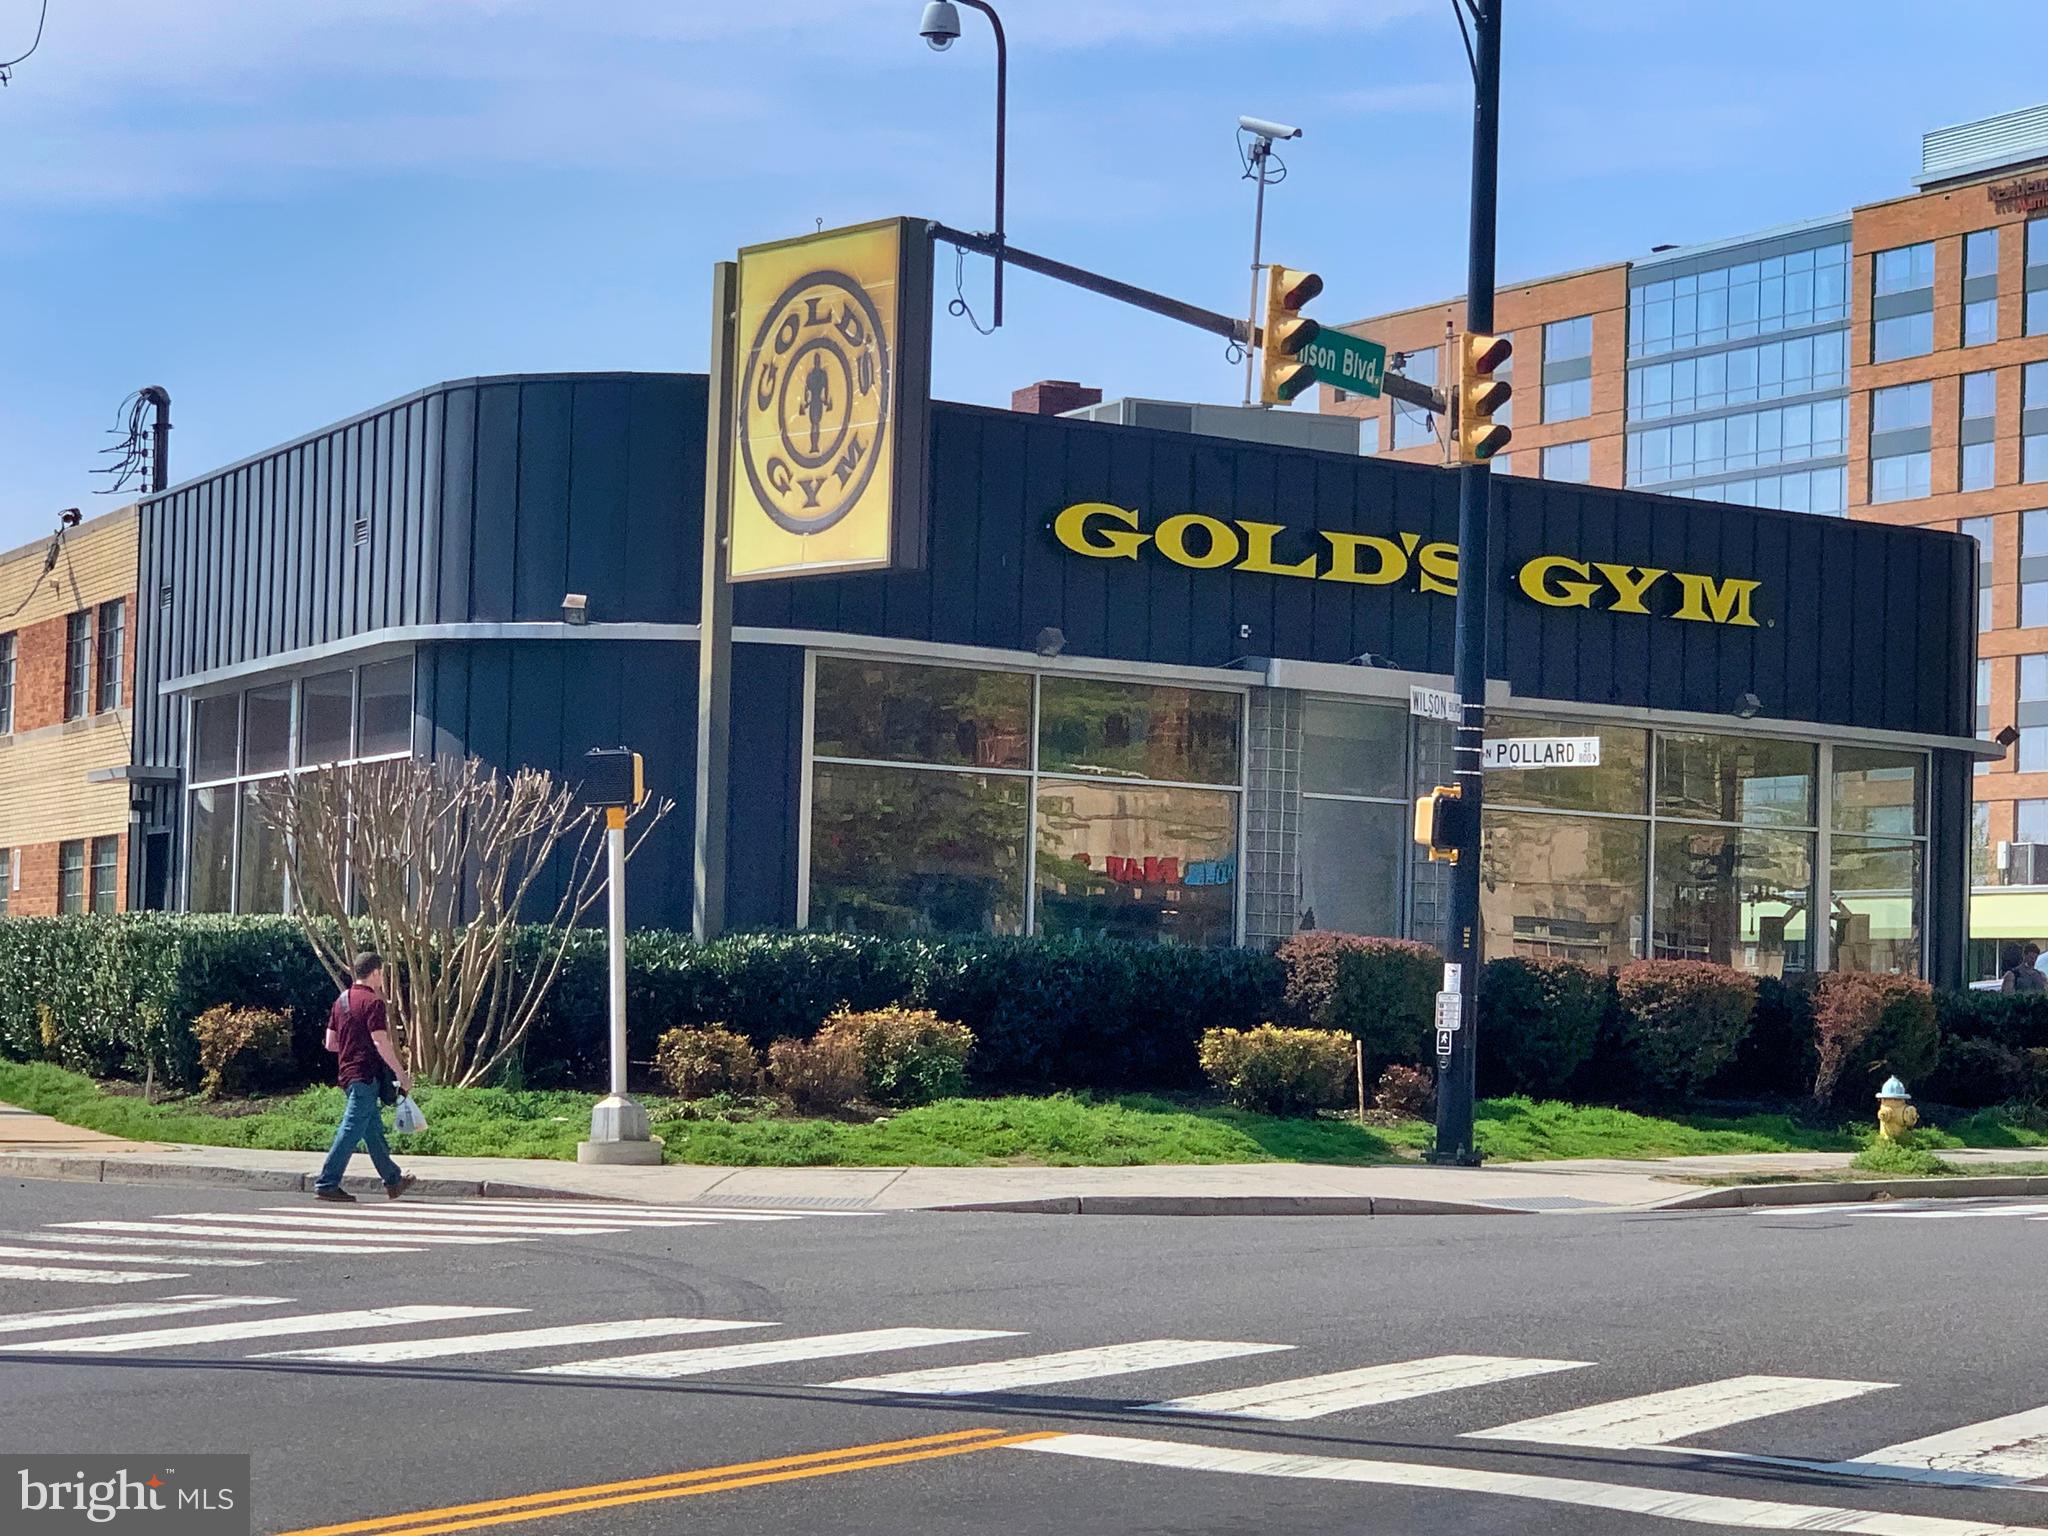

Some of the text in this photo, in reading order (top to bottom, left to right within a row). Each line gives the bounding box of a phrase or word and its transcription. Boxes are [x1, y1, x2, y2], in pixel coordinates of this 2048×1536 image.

[757, 297, 874, 412] GOLD'S
[1342, 347, 1379, 384] Blvd.
[767, 430, 870, 509] GYM
[1054, 502, 1763, 627] GOLD'S GYM
[1412, 690, 1447, 716] WILSON
[1486, 742, 1592, 763] N POLLARD ST
